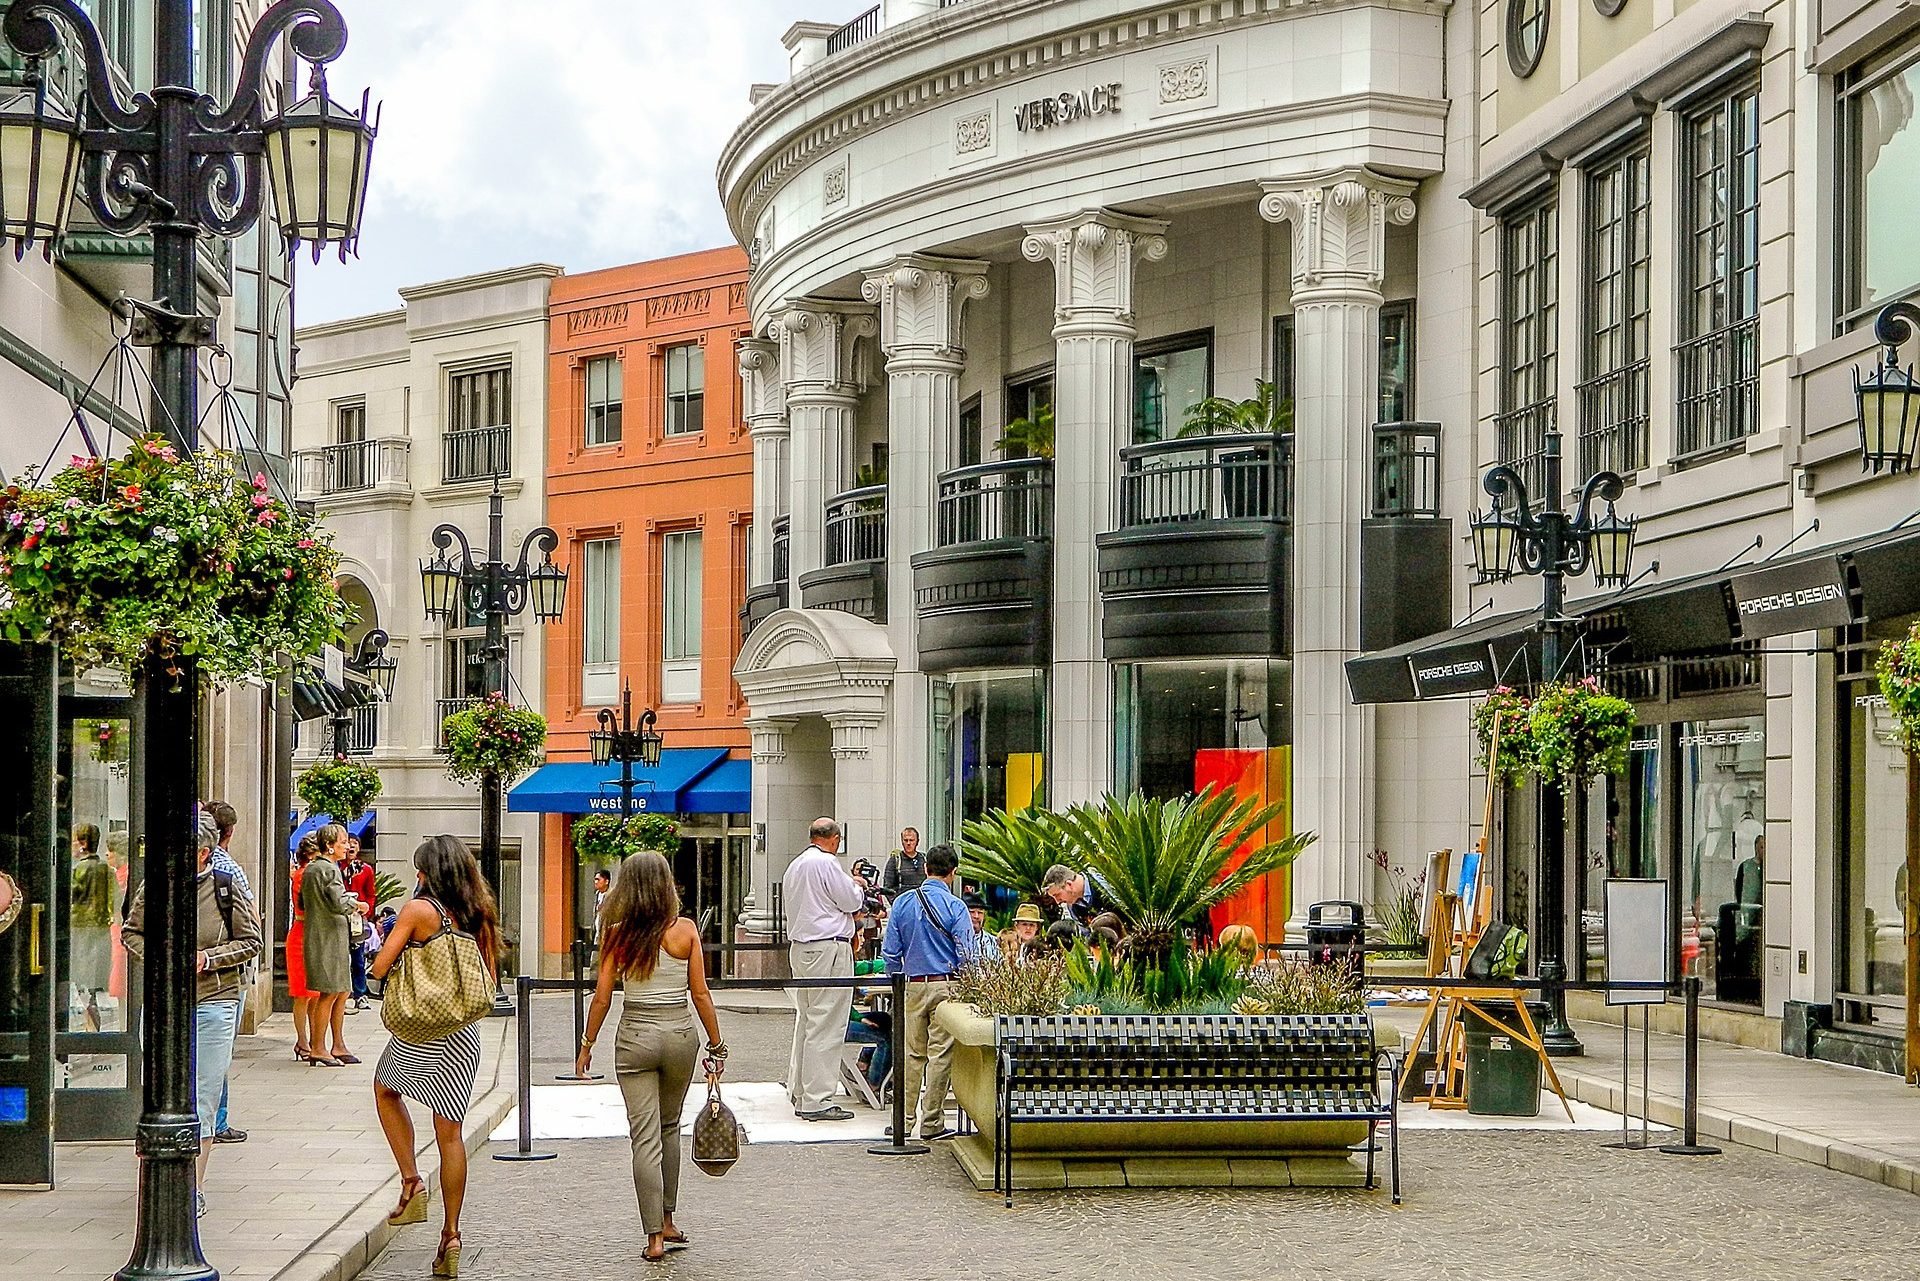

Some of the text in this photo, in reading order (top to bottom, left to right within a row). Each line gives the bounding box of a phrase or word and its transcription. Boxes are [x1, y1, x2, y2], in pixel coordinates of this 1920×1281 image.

[1013, 83, 1122, 133] VERSACE
[1739, 583, 1844, 615] PORSCHE DESIGN
[1418, 660, 1484, 680] PORSCHE DESIGN
[1679, 734, 1726, 747] PORSCHE
